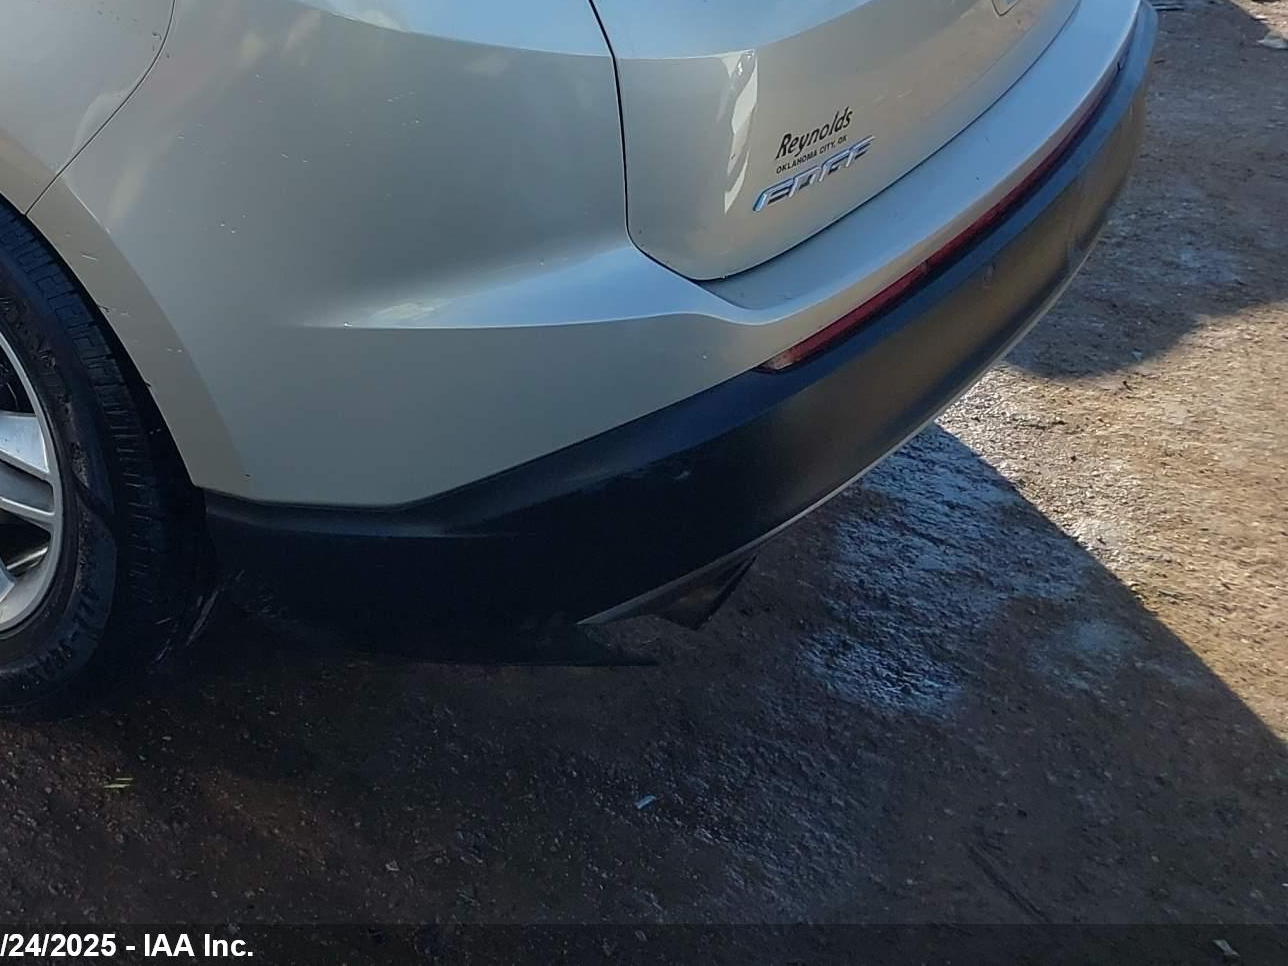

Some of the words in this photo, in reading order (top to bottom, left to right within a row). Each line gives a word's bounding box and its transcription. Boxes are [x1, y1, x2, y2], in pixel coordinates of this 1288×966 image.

[775, 106, 853, 161] Reynolds
[776, 150, 817, 174] OKLAHOMA
[837, 134, 847, 145] OK
